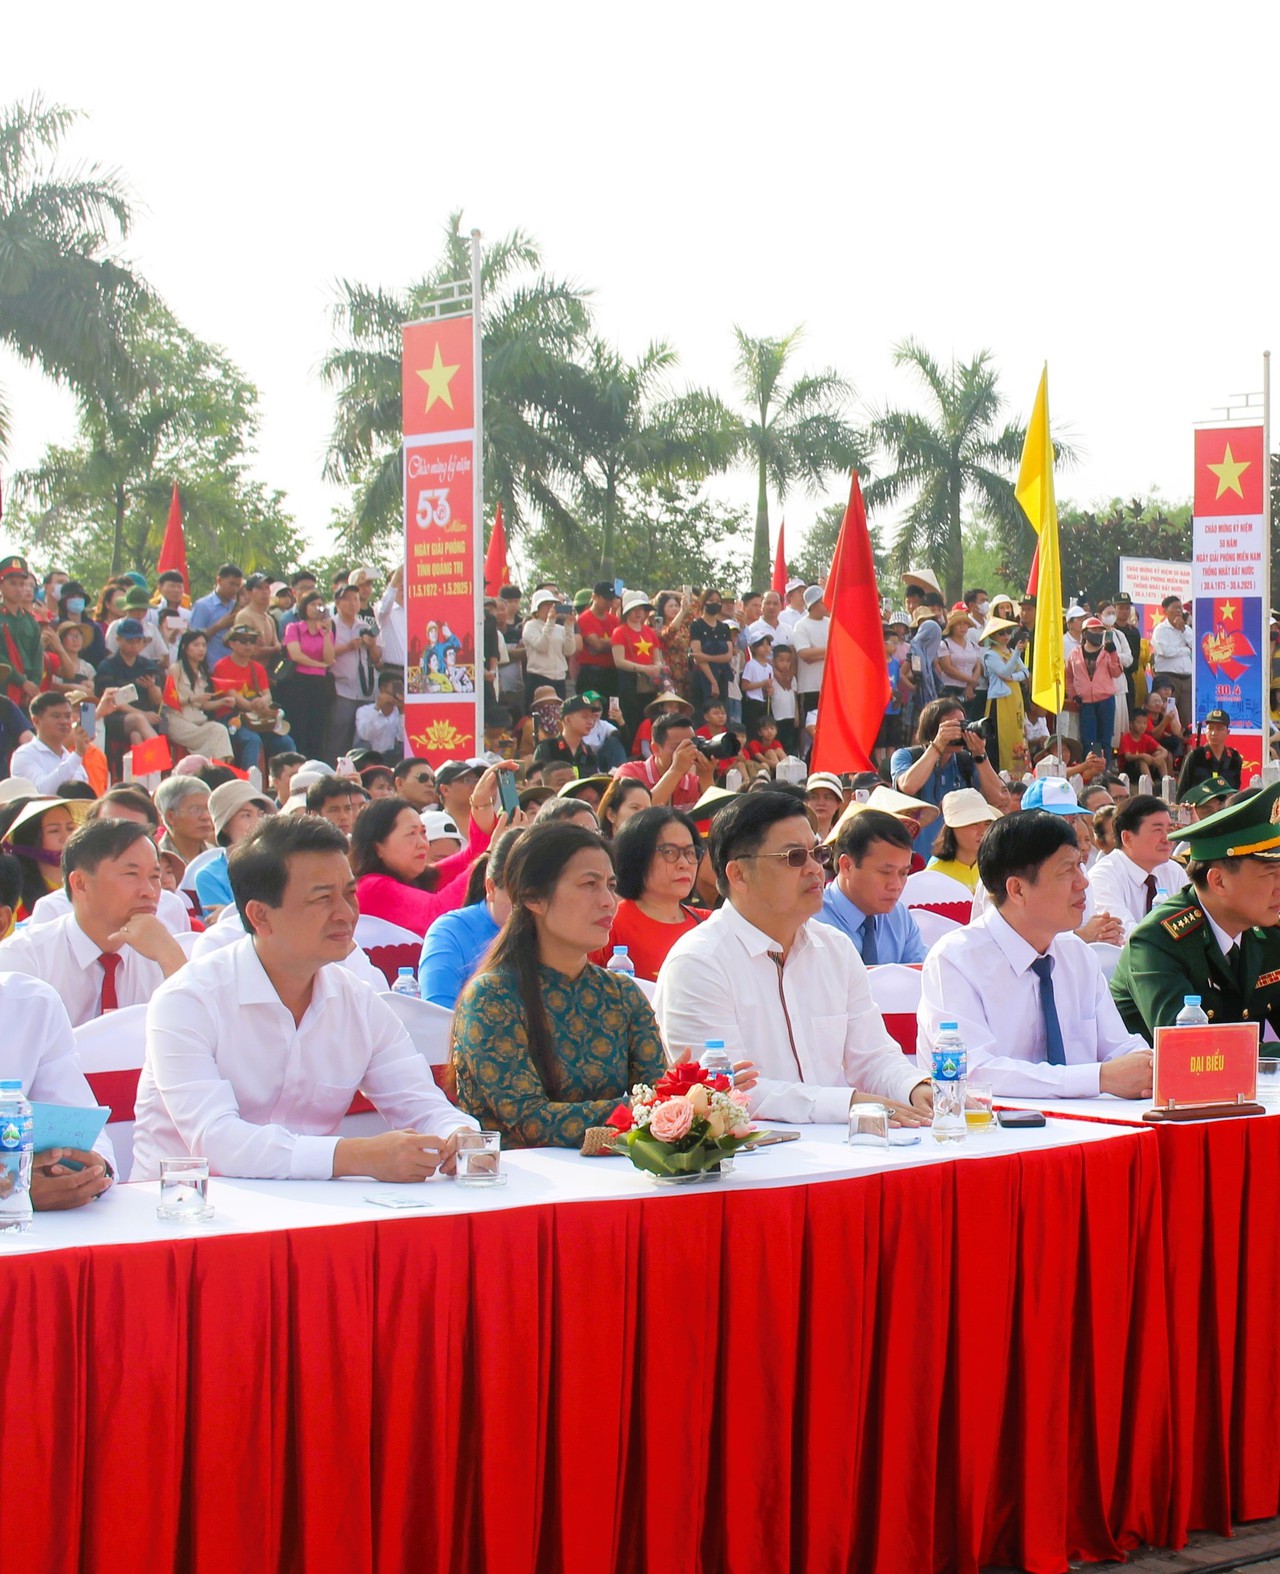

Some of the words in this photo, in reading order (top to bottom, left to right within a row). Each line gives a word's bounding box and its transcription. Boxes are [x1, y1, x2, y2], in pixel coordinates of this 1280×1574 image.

[416, 487, 450, 529] 53
[1190, 1056, 1204, 1076] ĐẠI
[1206, 1048, 1224, 1072] BIỂU
